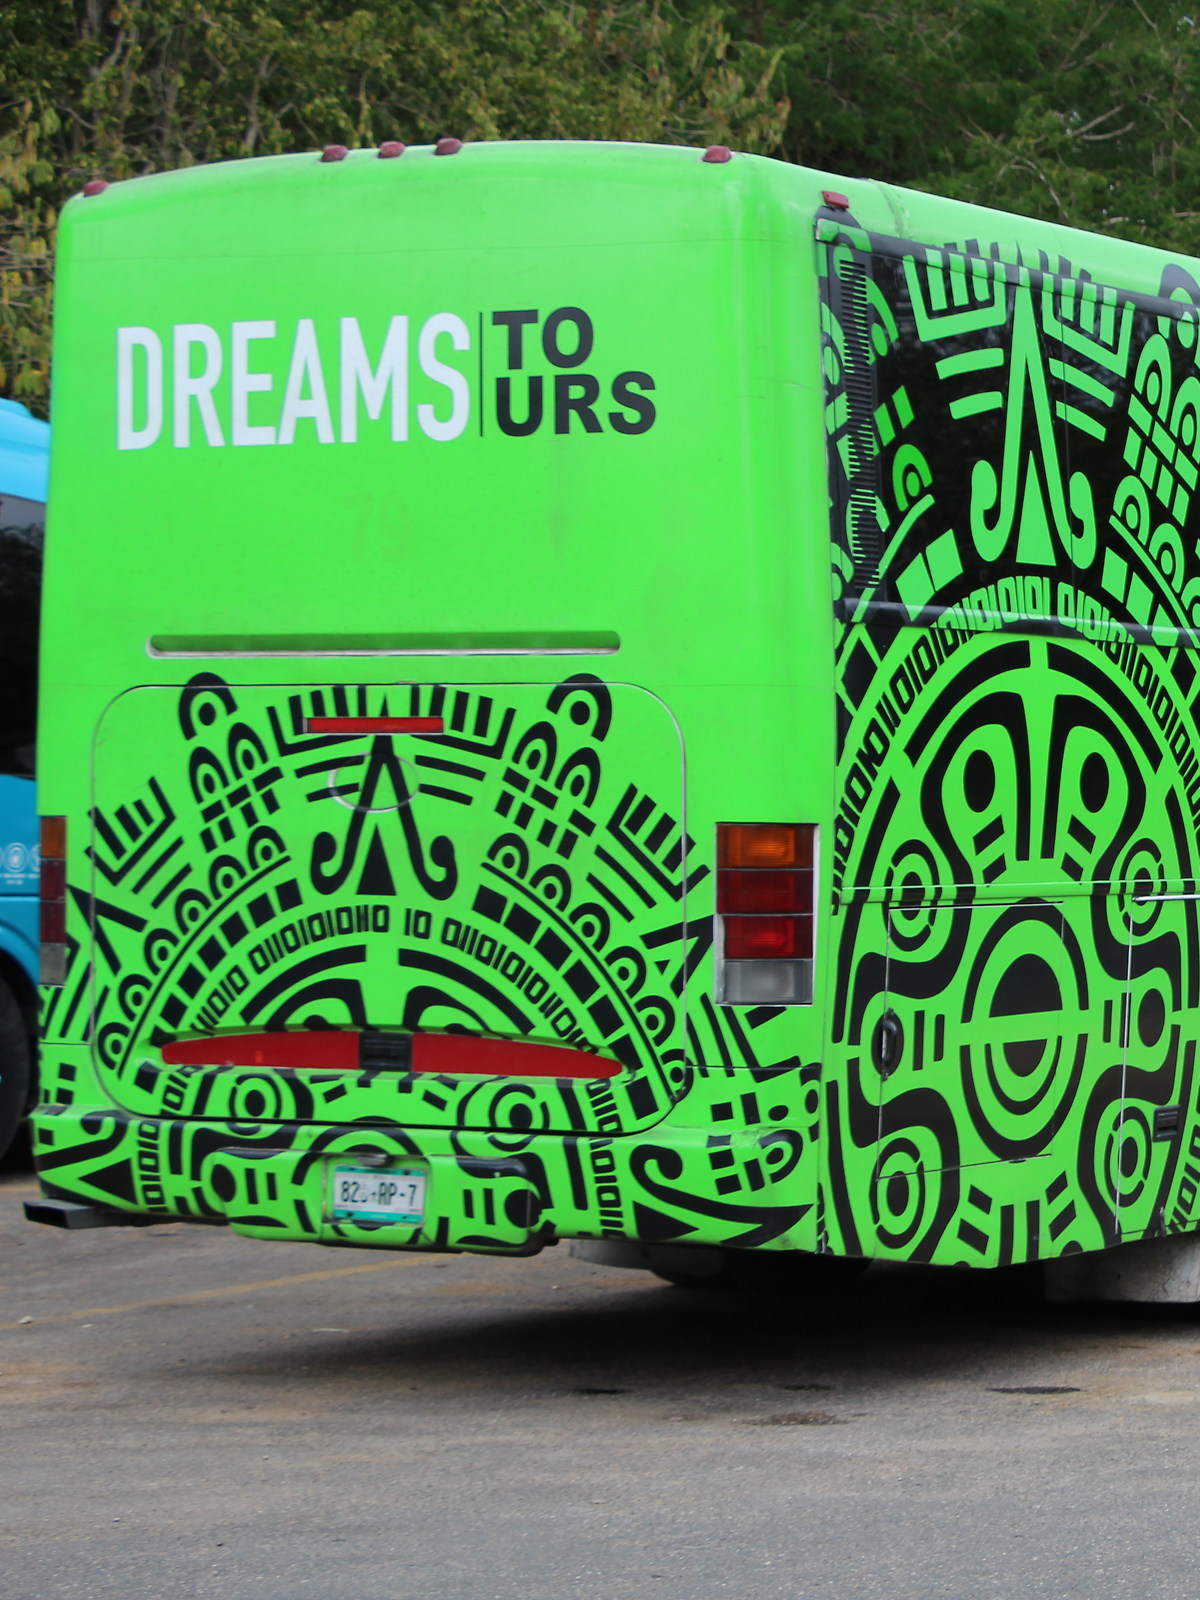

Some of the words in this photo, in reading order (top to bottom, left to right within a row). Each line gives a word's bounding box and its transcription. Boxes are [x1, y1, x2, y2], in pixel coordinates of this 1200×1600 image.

[492, 306, 594, 370] TO
[117, 312, 471, 451] DREAMS
[495, 371, 656, 437] URS
